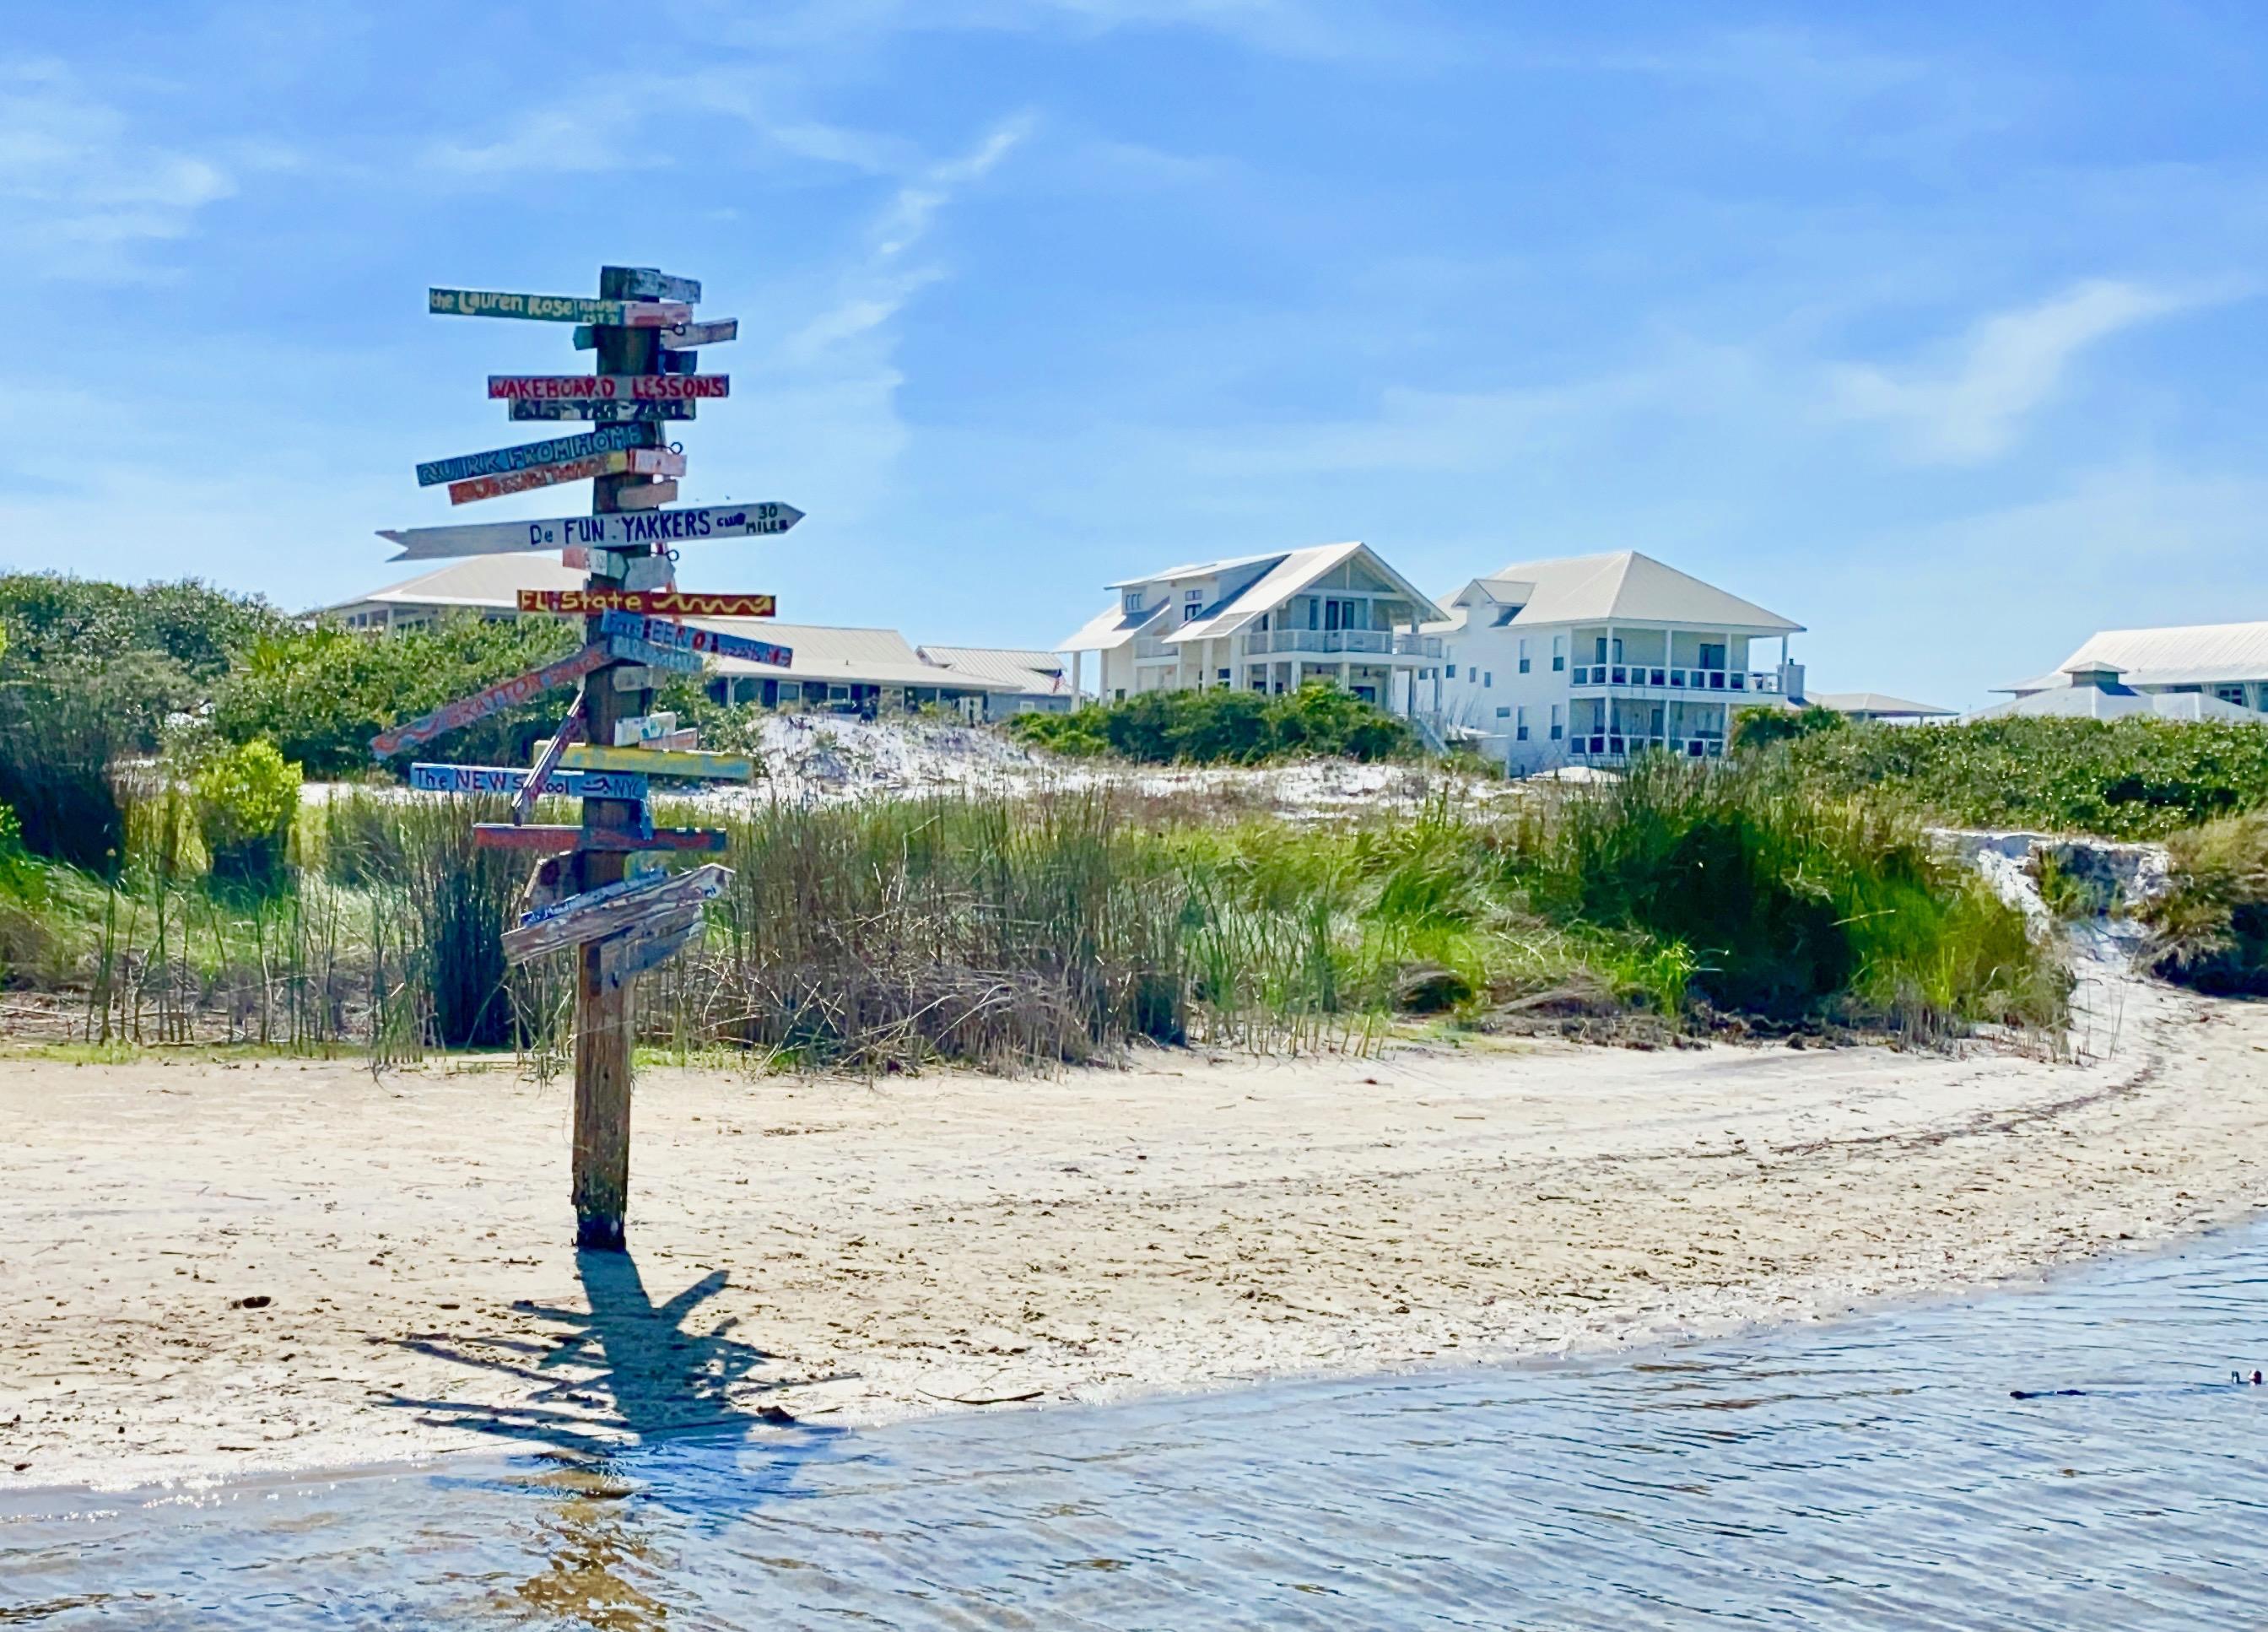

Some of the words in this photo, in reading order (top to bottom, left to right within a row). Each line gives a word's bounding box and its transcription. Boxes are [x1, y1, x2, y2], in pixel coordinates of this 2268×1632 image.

[491, 377, 616, 398] WAKEBOARD
[632, 377, 724, 398] LESSONS
[508, 436, 571, 466] FROM
[575, 424, 643, 455] HOME
[759, 504, 778, 520] 30
[529, 525, 554, 545] De
[564, 519, 606, 544] FUN
[622, 511, 711, 543] YAKKERS
[560, 591, 642, 612] State
[414, 767, 447, 788] The
[455, 769, 506, 791] NEW
[512, 775, 570, 794] Sool
[613, 780, 642, 797] NYC
